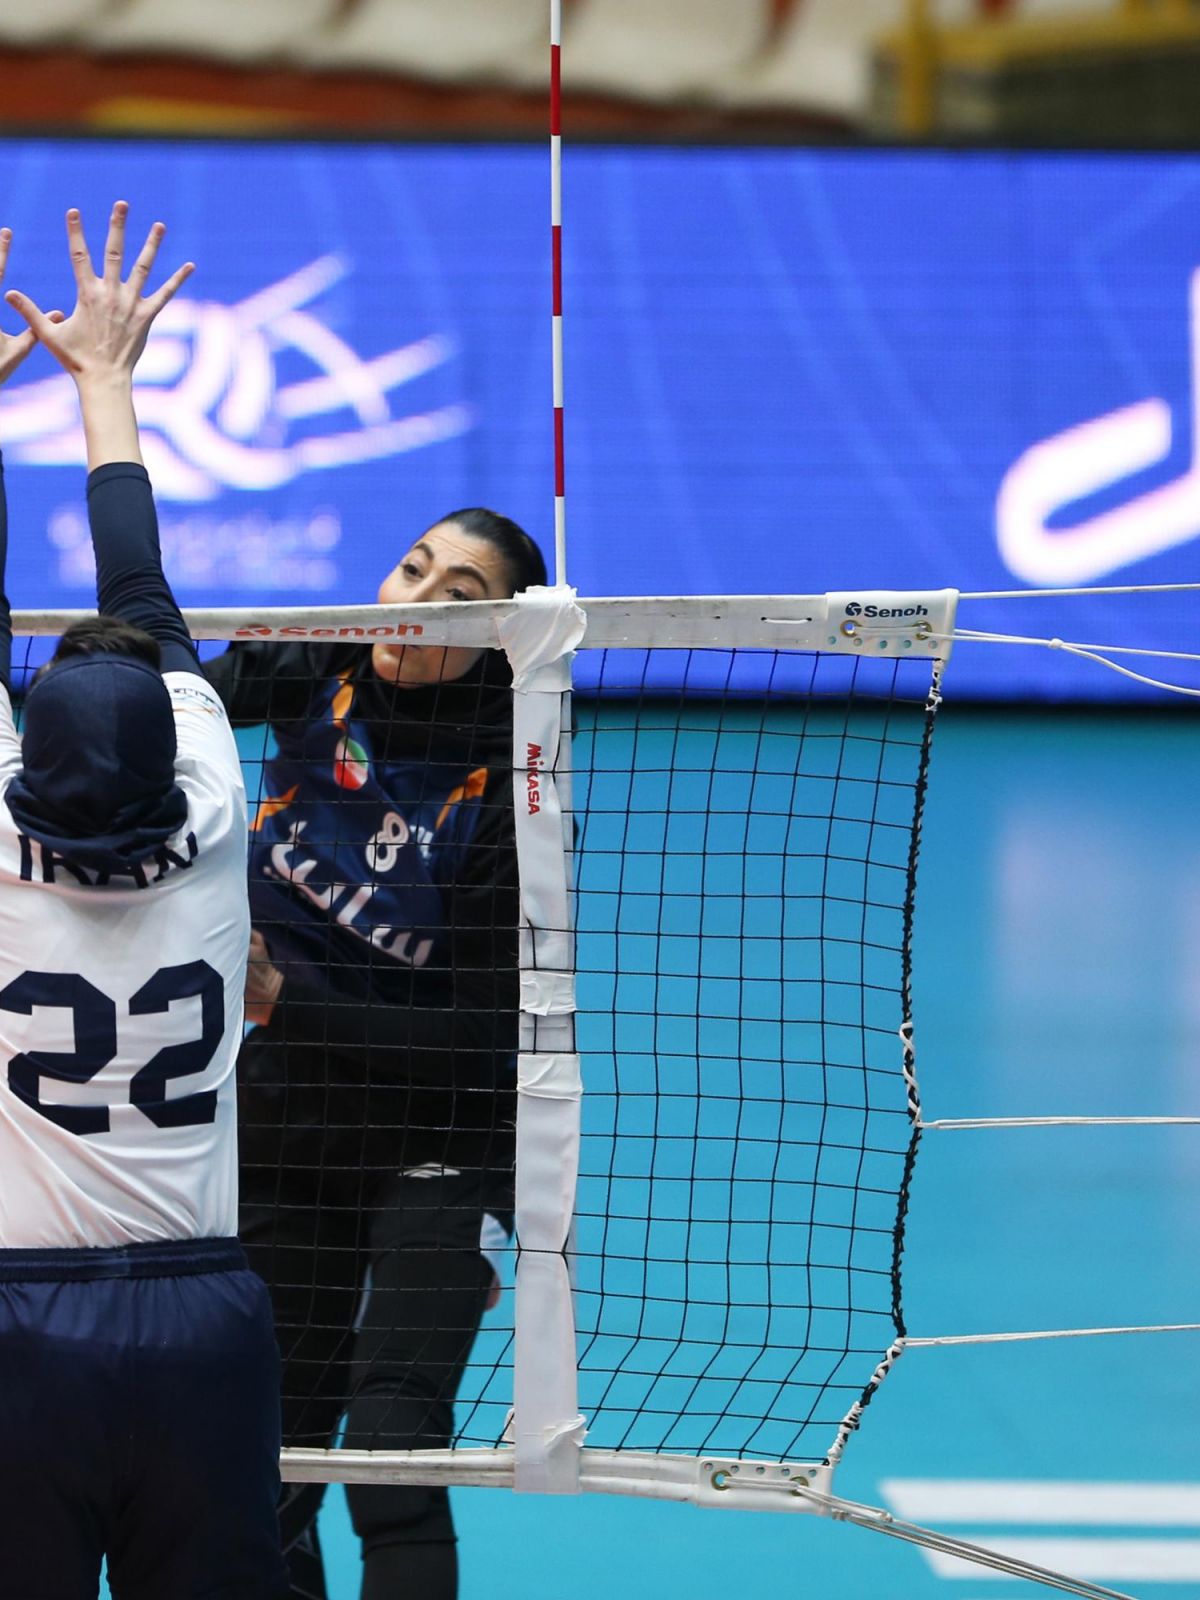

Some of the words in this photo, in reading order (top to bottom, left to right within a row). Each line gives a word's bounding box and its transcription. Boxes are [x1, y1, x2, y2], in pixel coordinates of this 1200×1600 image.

[864, 605, 928, 618] Senoh
[279, 624, 424, 637] Senoh
[365, 811, 410, 873] 8
